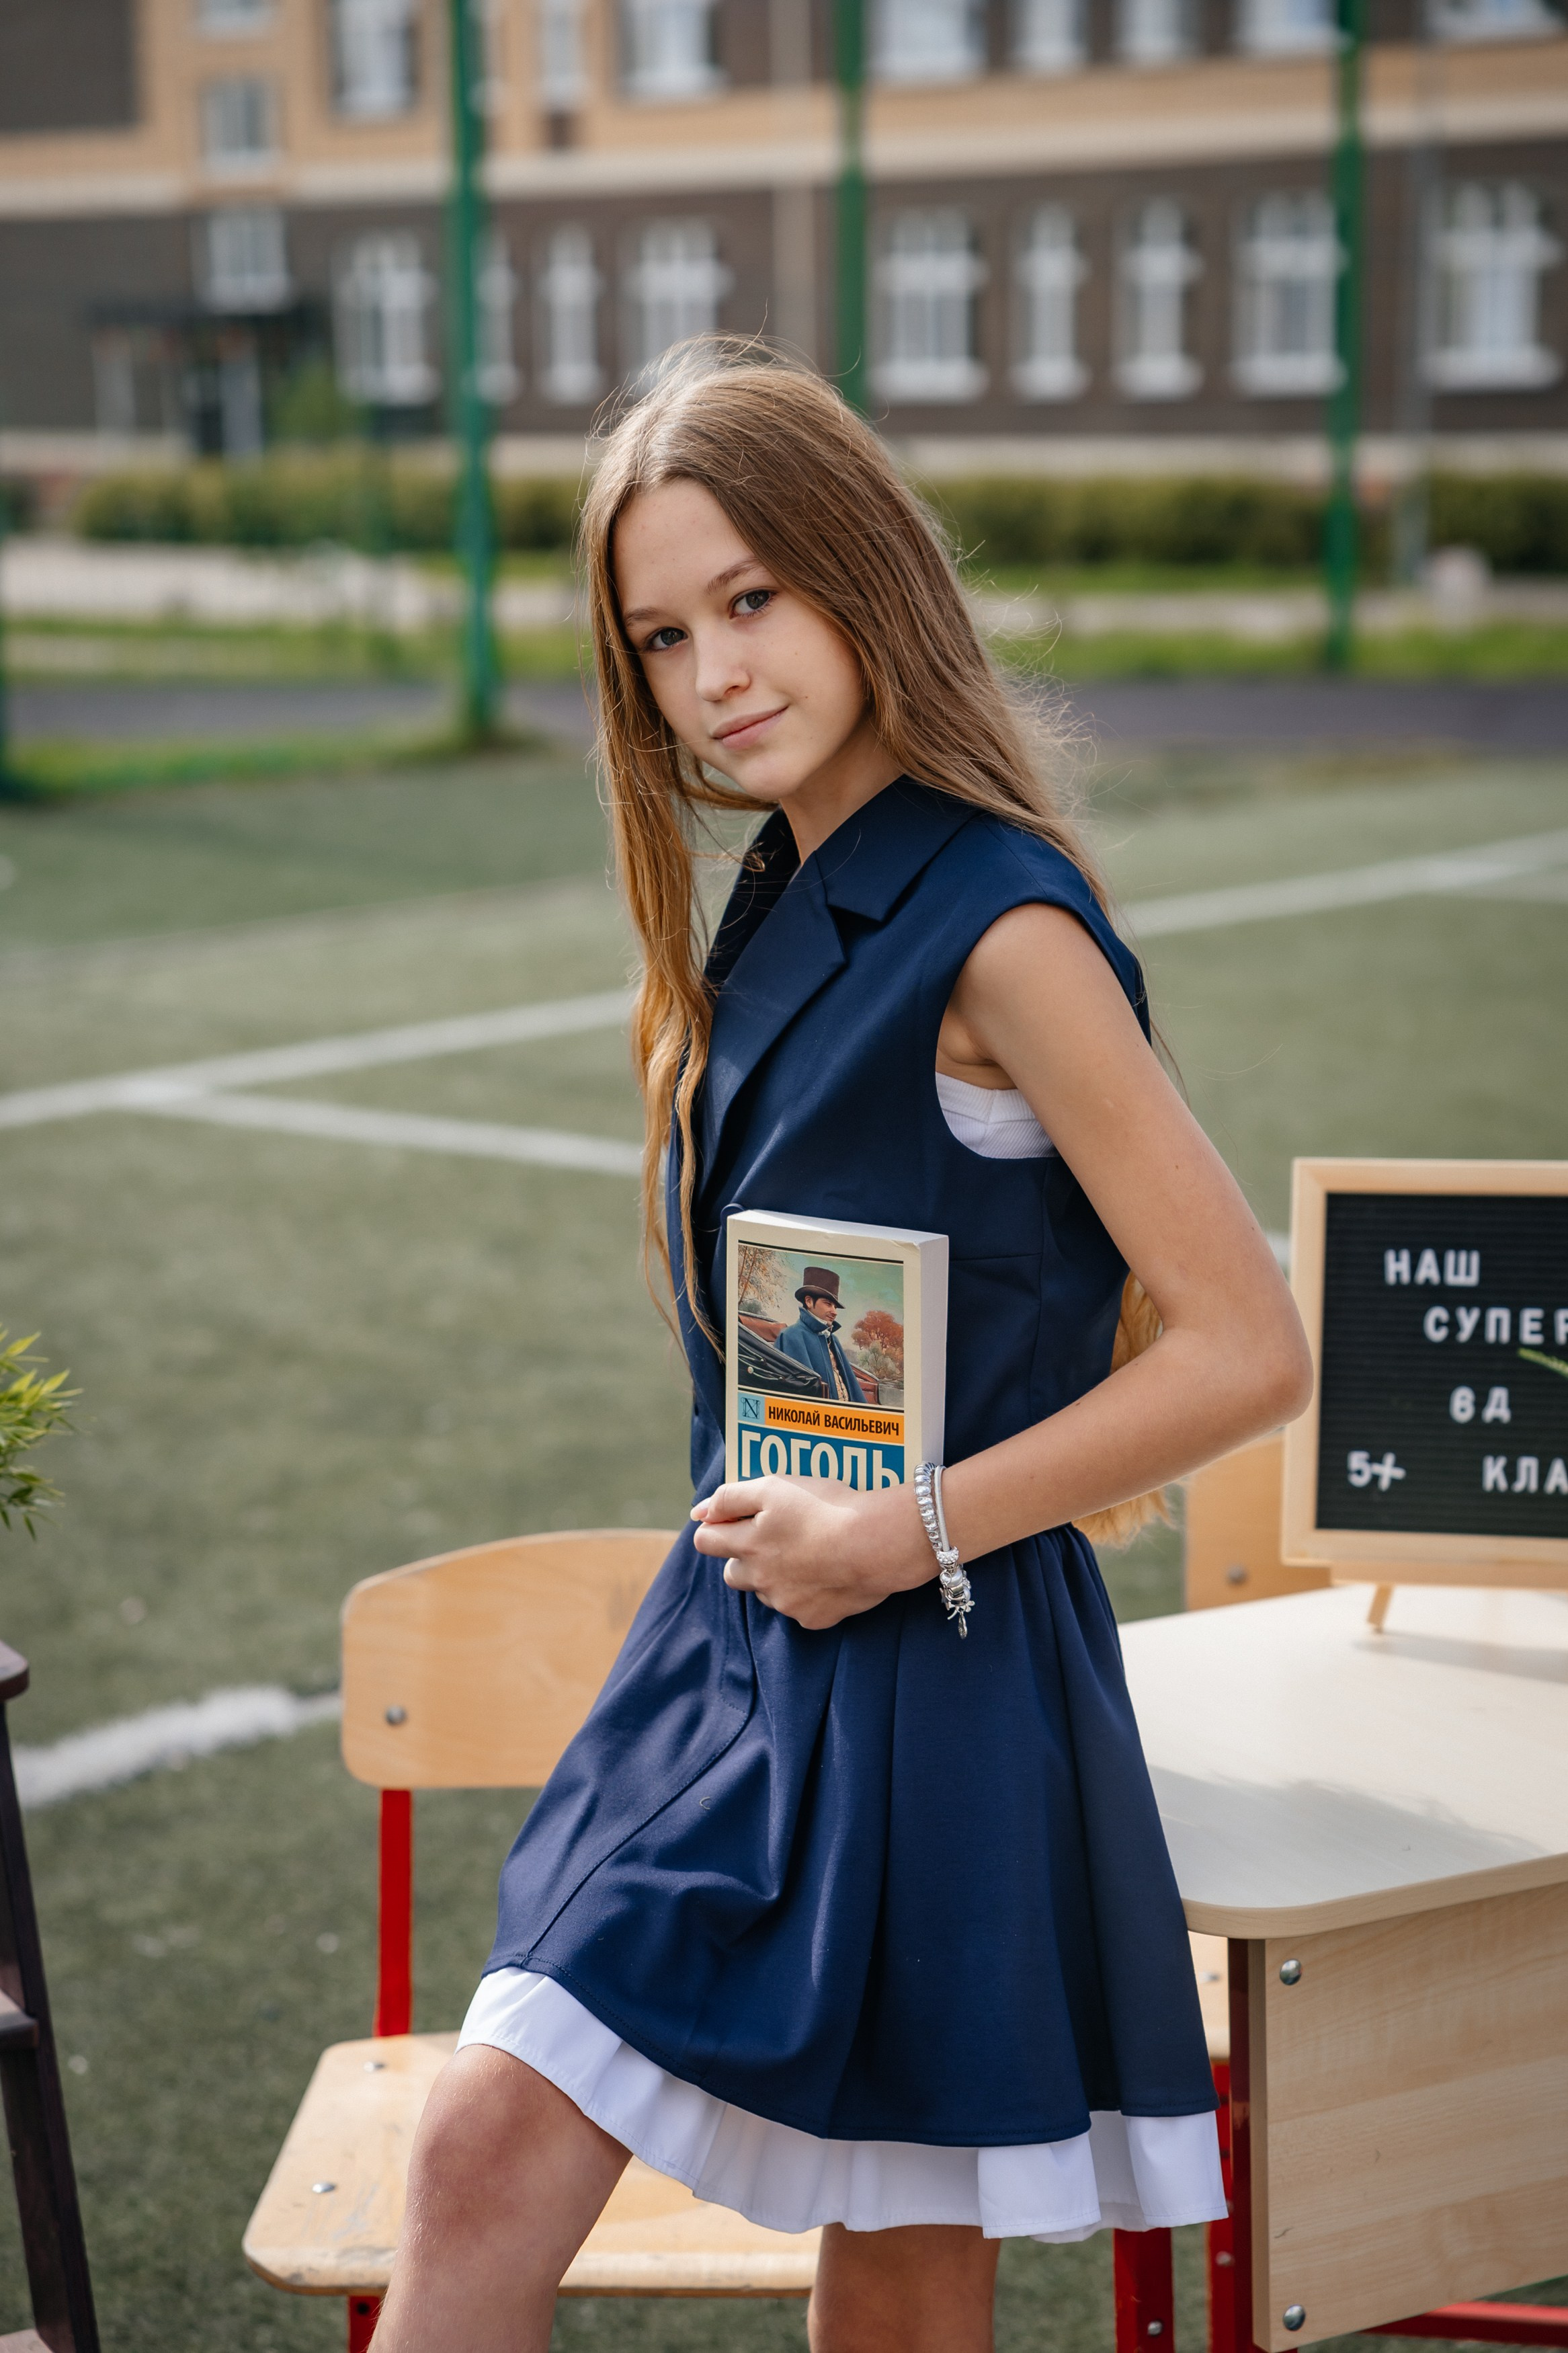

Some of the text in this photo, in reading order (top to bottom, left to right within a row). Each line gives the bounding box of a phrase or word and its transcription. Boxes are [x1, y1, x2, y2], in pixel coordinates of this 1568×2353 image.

[1384, 1248, 1480, 1287] НАШ
[1423, 1306, 1568, 1345] СУПЕР
[768, 1406, 899, 1436] НИКОЛАЙ ВАСИЛЬЕВИЧ
[1449, 1386, 1512, 1423] 6Д
[741, 1429, 900, 1491] ГОГОЛЬ
[1347, 1450, 1406, 1492] 5+
[1482, 1455, 1568, 1495] КЛА
